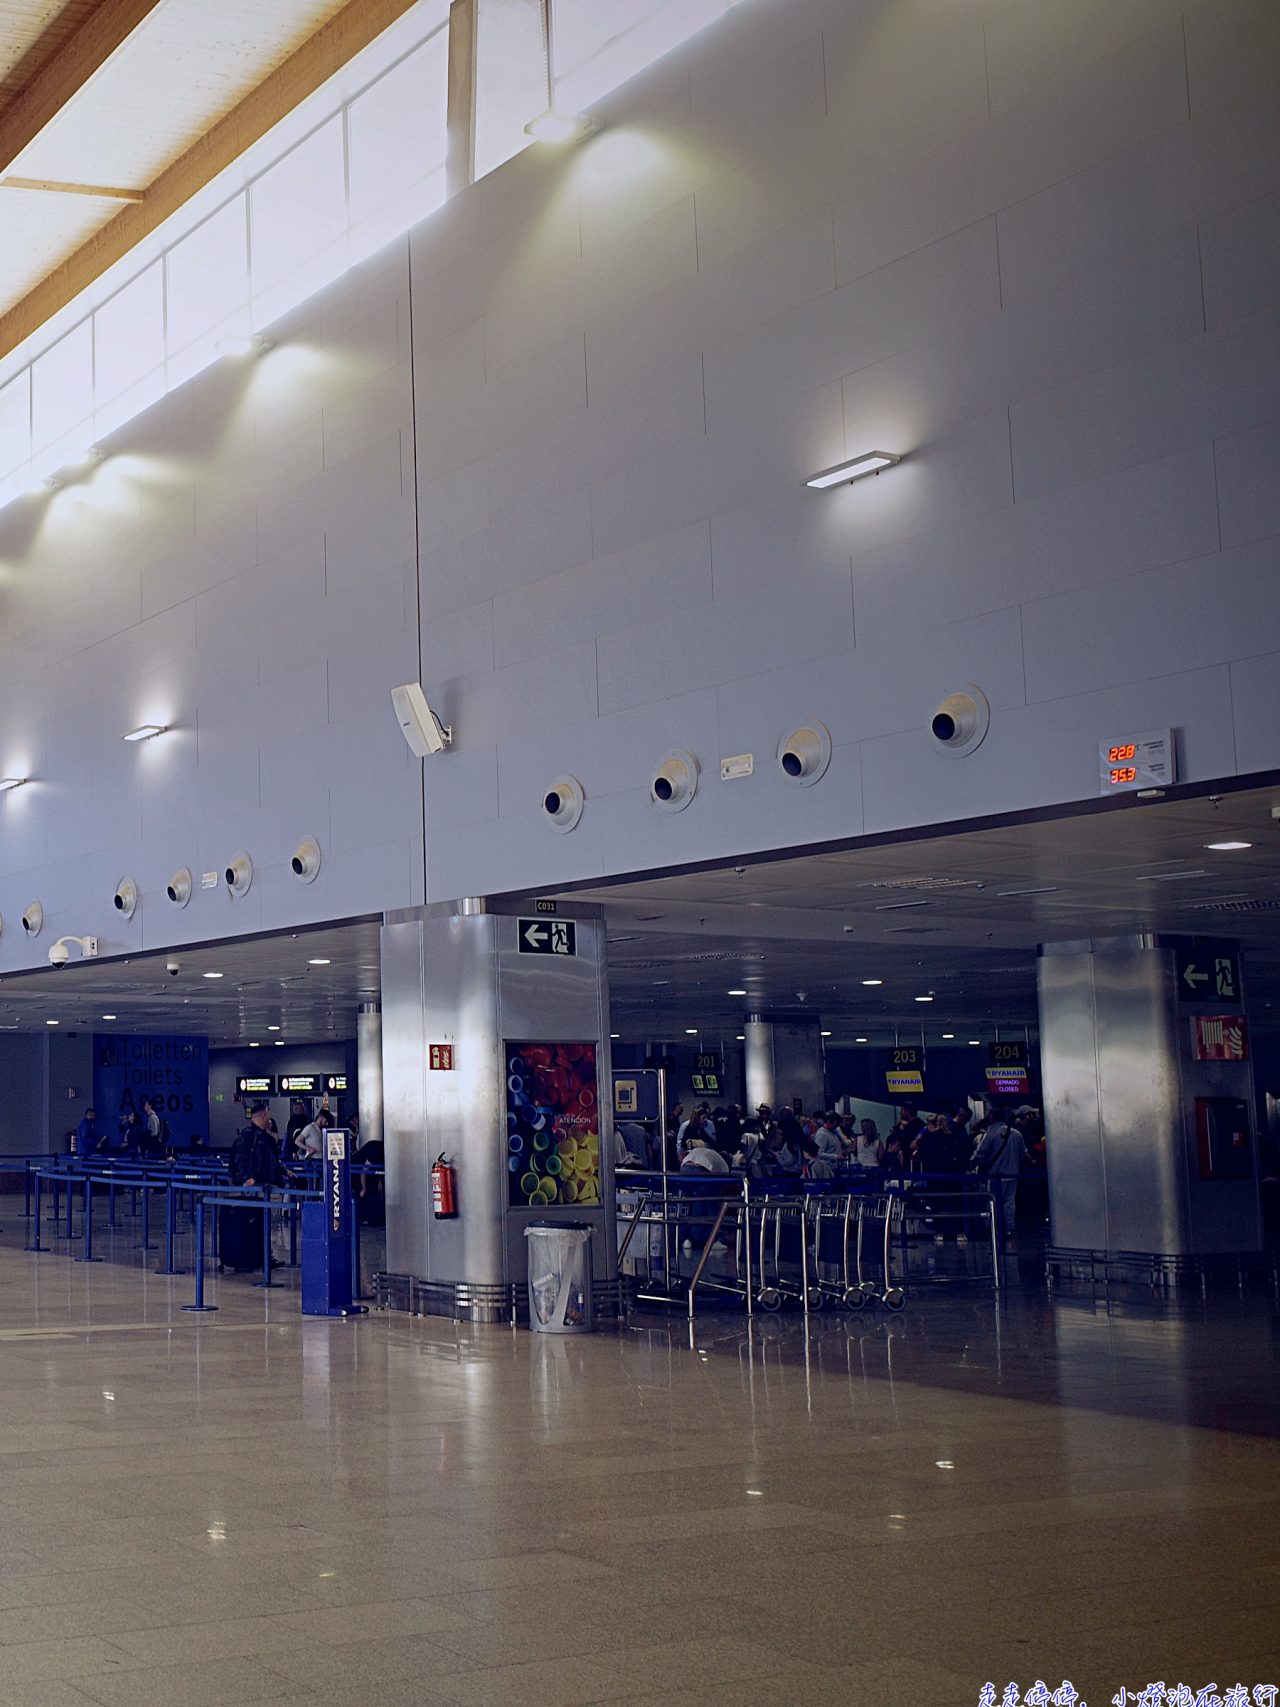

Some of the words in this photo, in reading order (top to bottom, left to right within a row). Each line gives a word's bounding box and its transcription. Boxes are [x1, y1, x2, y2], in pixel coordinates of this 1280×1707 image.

[537, 902, 555, 911] C031
[120, 1039, 202, 1060] Toiletten
[894, 1050, 916, 1063] 203
[995, 1045, 1020, 1059] 204
[698, 1056, 715, 1068] 201
[120, 1063, 183, 1085] Toilets
[120, 1088, 194, 1112] Aseos
